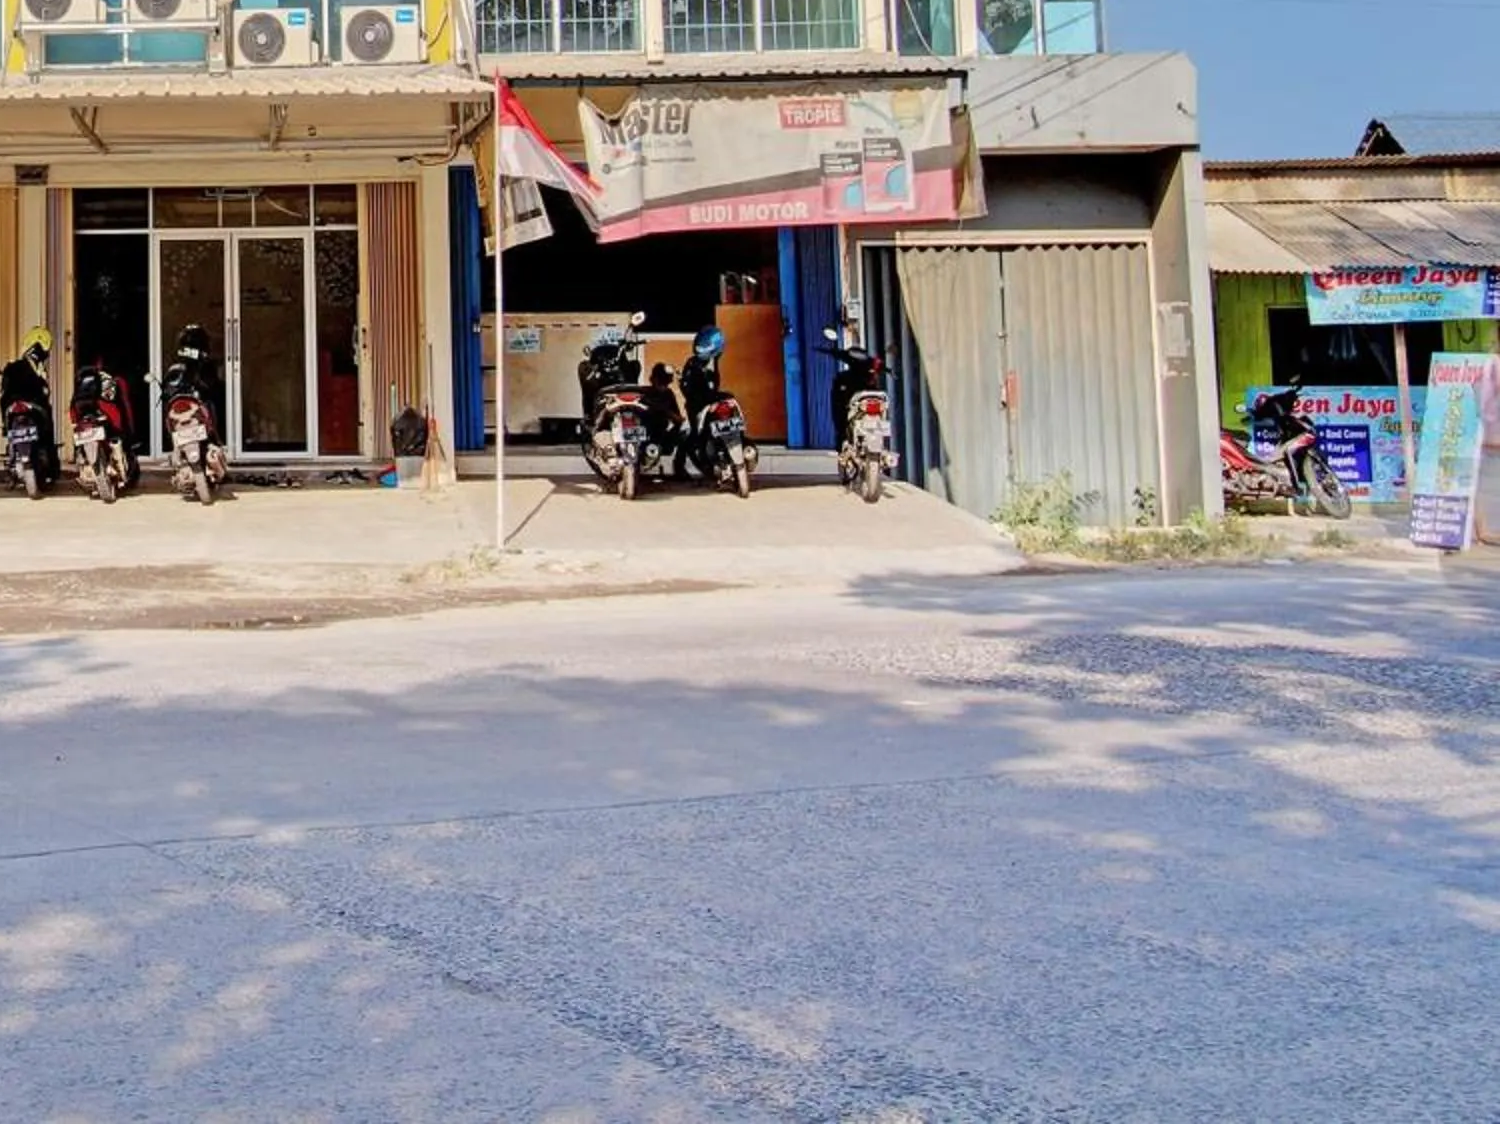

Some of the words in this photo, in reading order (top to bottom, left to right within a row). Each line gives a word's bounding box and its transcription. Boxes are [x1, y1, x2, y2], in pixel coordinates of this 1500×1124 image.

[598, 102, 694, 145] Master
[688, 204, 733, 224] BUDI
[738, 201, 810, 222] MOTOR
[1411, 265, 1479, 288] Jaya
[1337, 393, 1397, 419] Jaya
